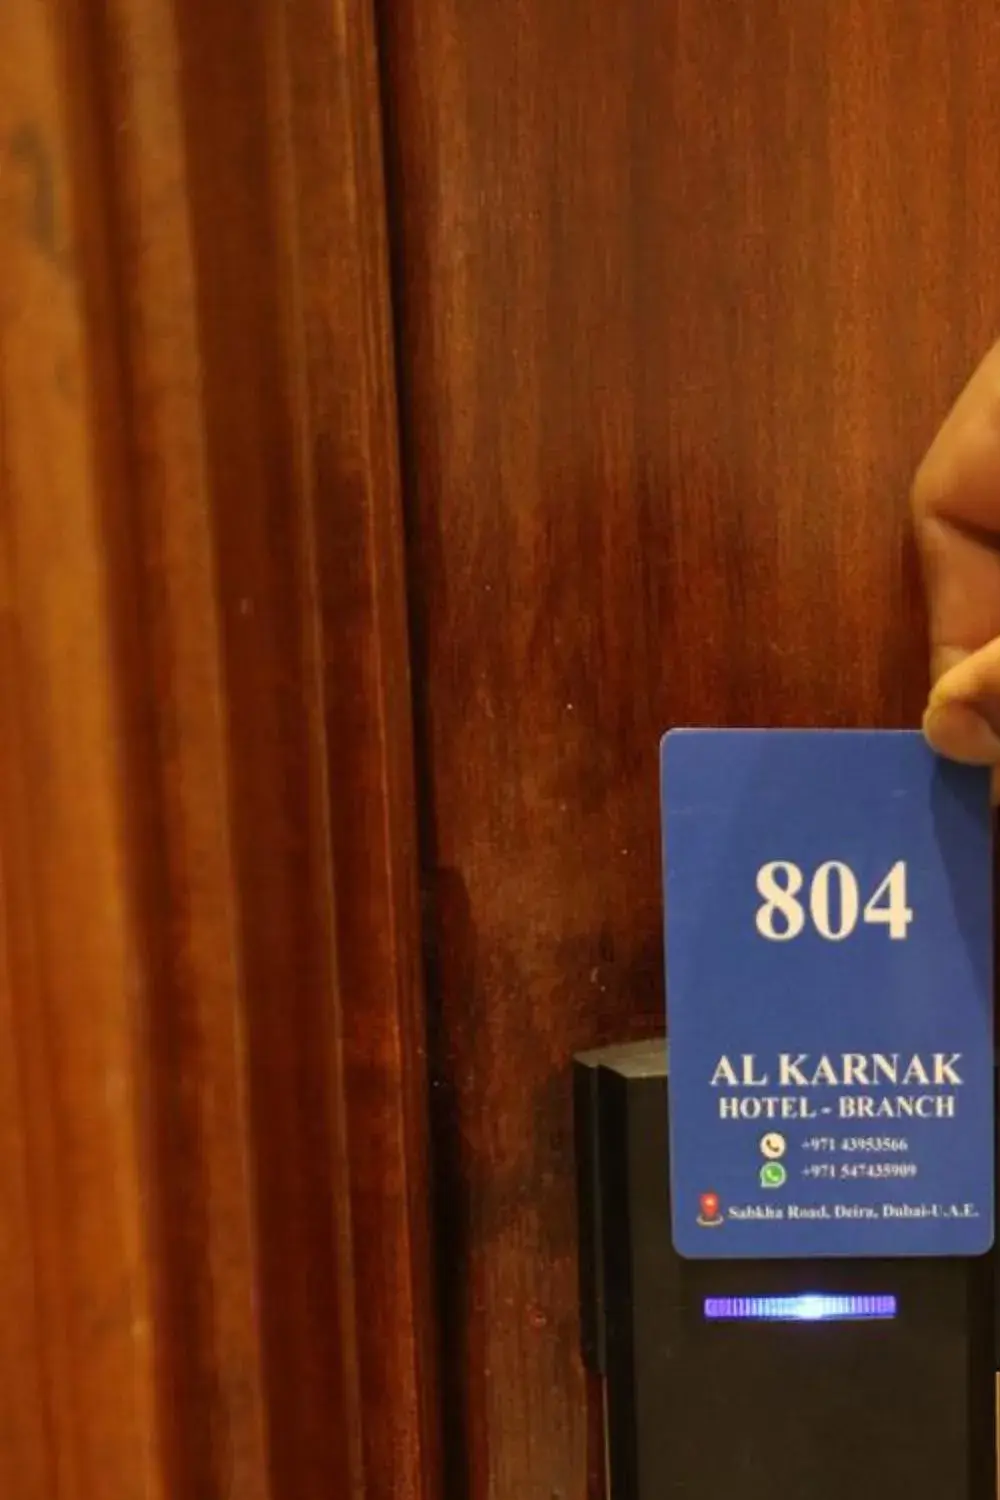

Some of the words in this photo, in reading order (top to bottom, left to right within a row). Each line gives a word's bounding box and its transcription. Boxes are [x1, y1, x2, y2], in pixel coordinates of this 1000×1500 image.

[755, 860, 913, 941] 804
[709, 1053, 769, 1087] AL
[778, 1052, 964, 1087] KARNAK
[718, 1096, 817, 1120] HOTEL
[838, 1094, 955, 1119] BRANCH
[801, 1136, 836, 1152] +971
[801, 1163, 836, 1179] +971
[727, 1204, 784, 1220] Sabkha
